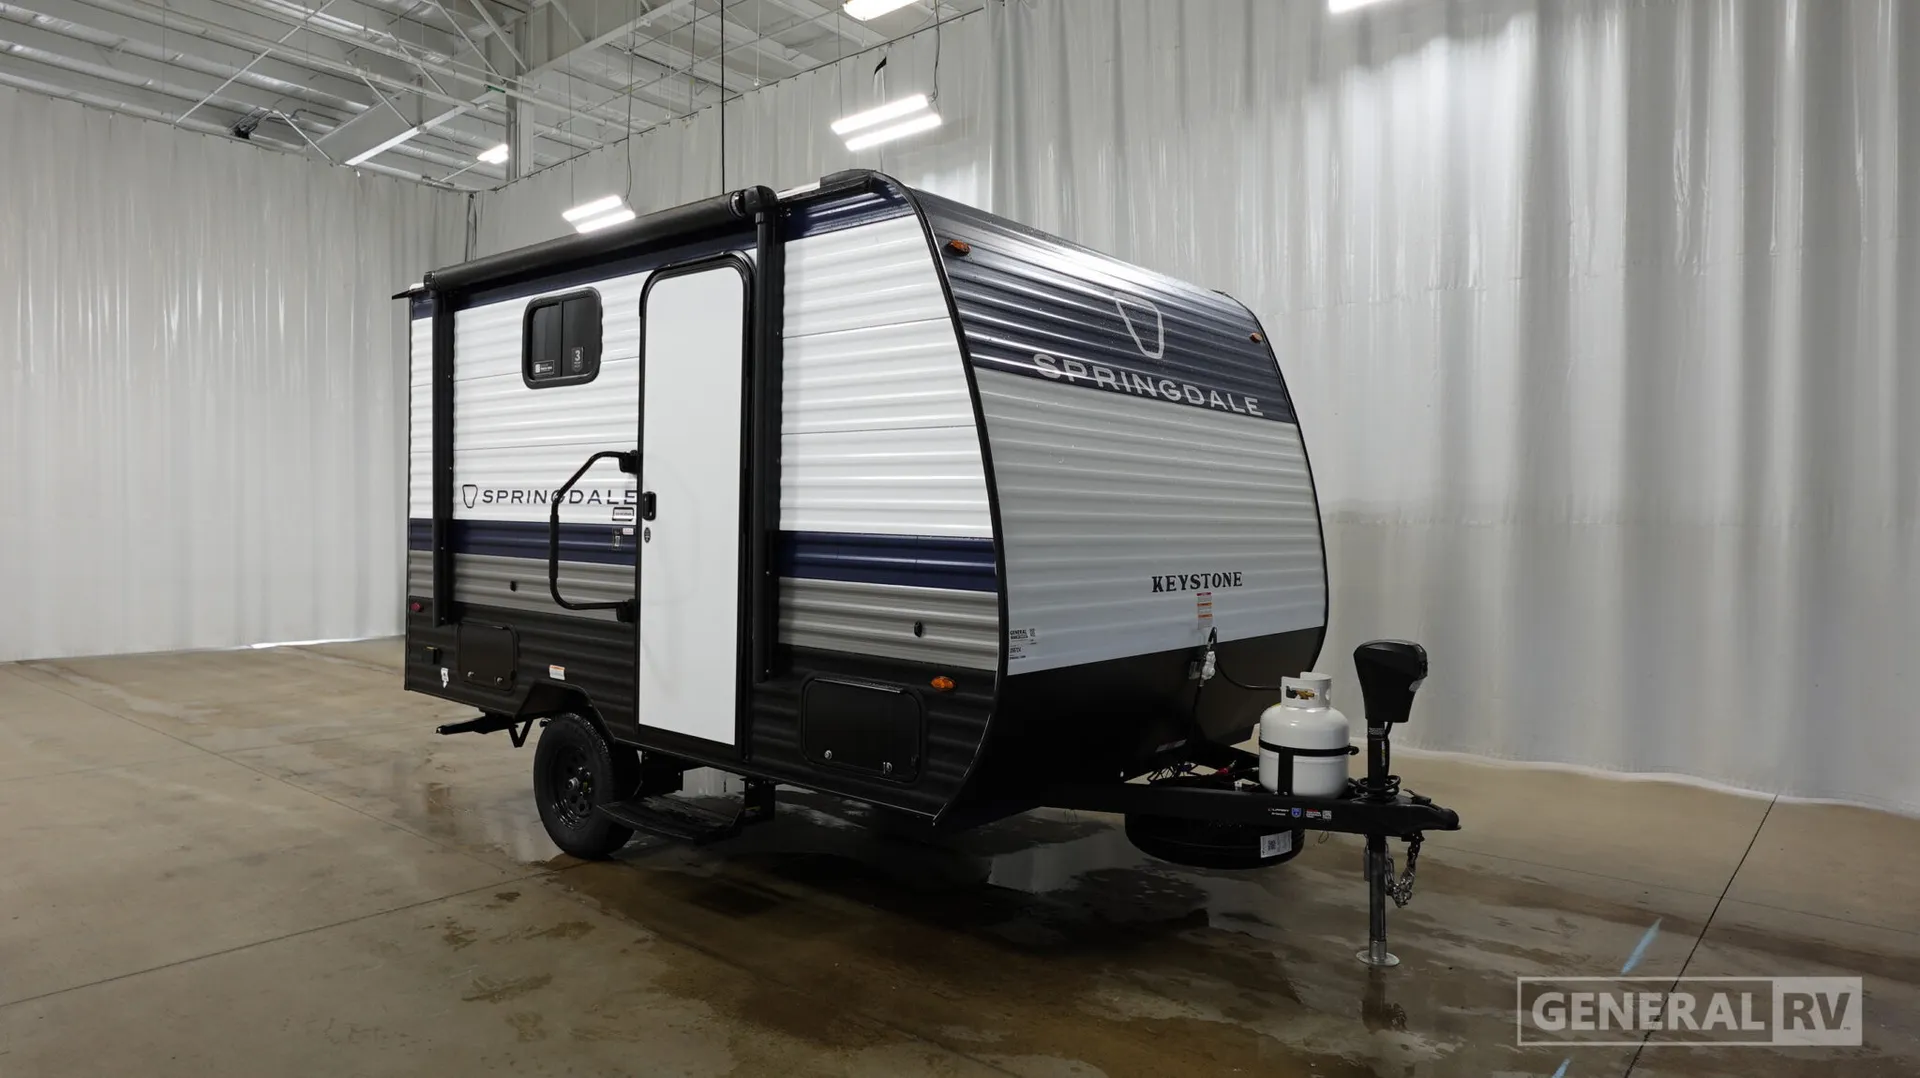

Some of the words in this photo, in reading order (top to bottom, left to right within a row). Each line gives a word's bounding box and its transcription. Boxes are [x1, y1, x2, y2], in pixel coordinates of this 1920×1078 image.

[574, 349, 581, 362] 3
[1033, 353, 1264, 416] SPRINGDALE
[1152, 572, 1243, 593] KEYSTONE
